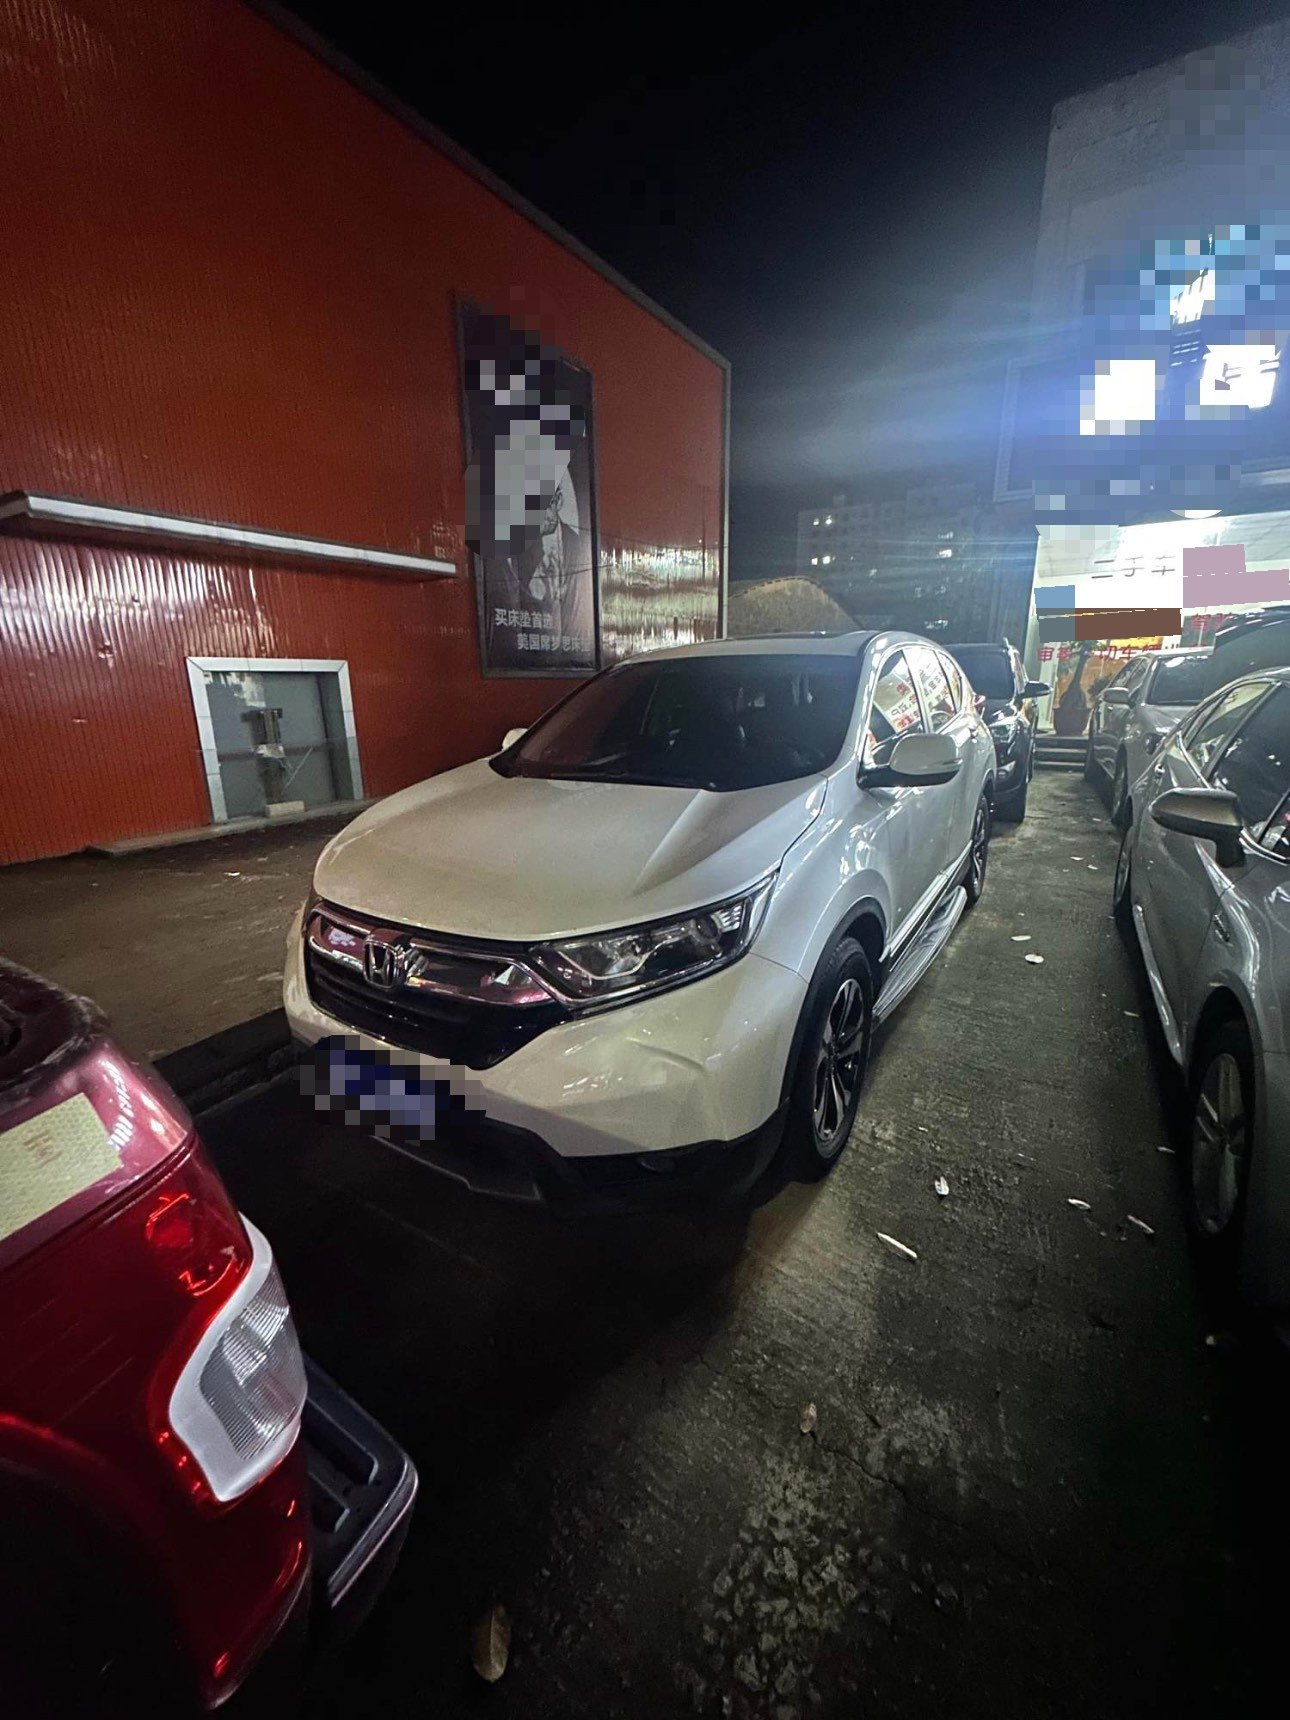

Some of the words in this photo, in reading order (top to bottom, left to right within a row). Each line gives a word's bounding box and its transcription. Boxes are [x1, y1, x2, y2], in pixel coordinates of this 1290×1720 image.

[494, 608, 553, 629] 买床垫首选
